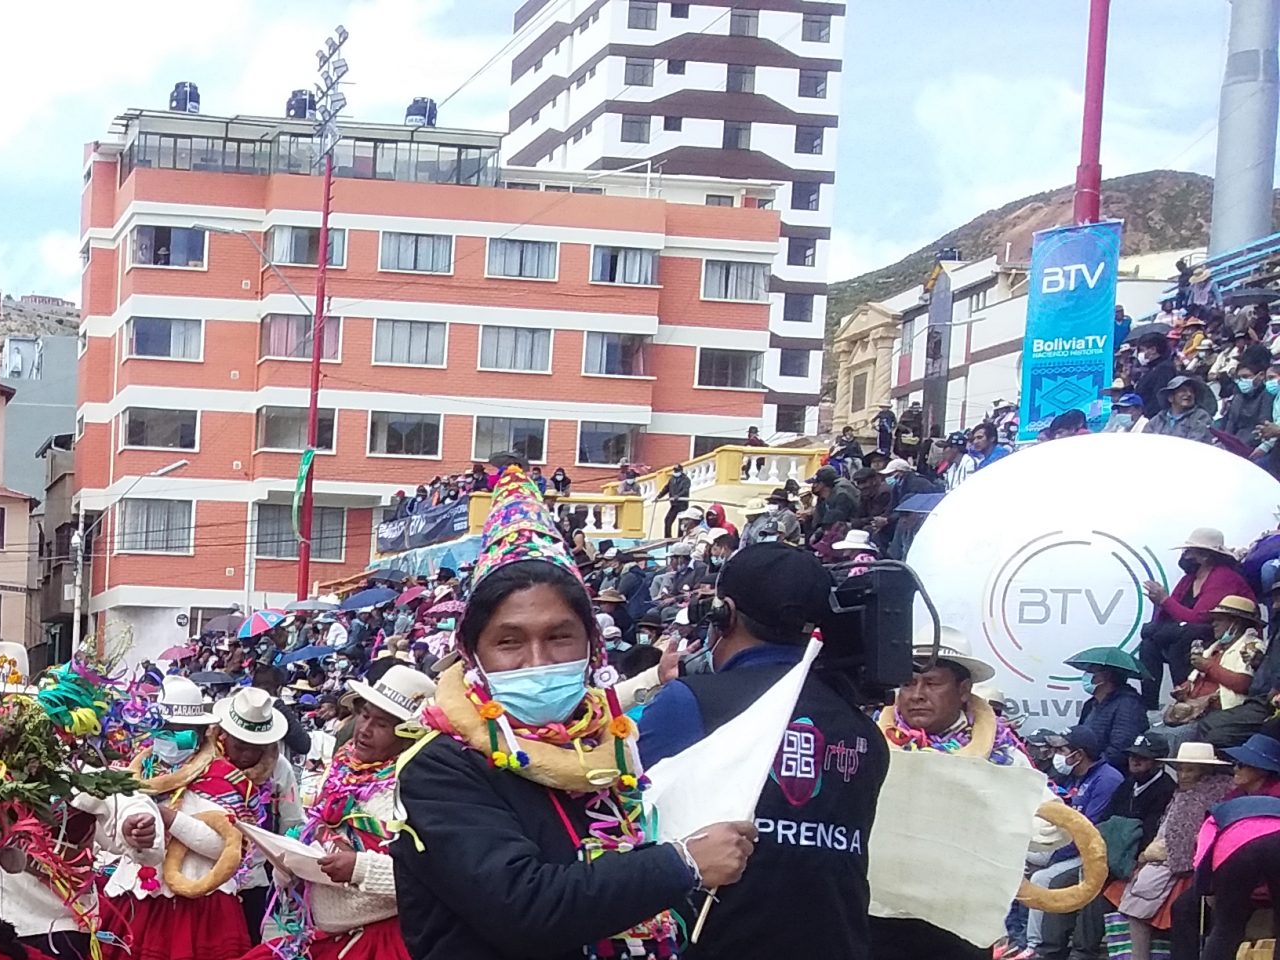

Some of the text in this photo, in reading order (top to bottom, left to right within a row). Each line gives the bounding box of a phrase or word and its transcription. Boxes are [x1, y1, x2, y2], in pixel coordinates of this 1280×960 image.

[1041, 261, 1105, 294] BTV
[1032, 334, 1108, 353] BoliviaTV
[1018, 588, 1125, 625] BTV
[754, 817, 862, 855] PRENSA
